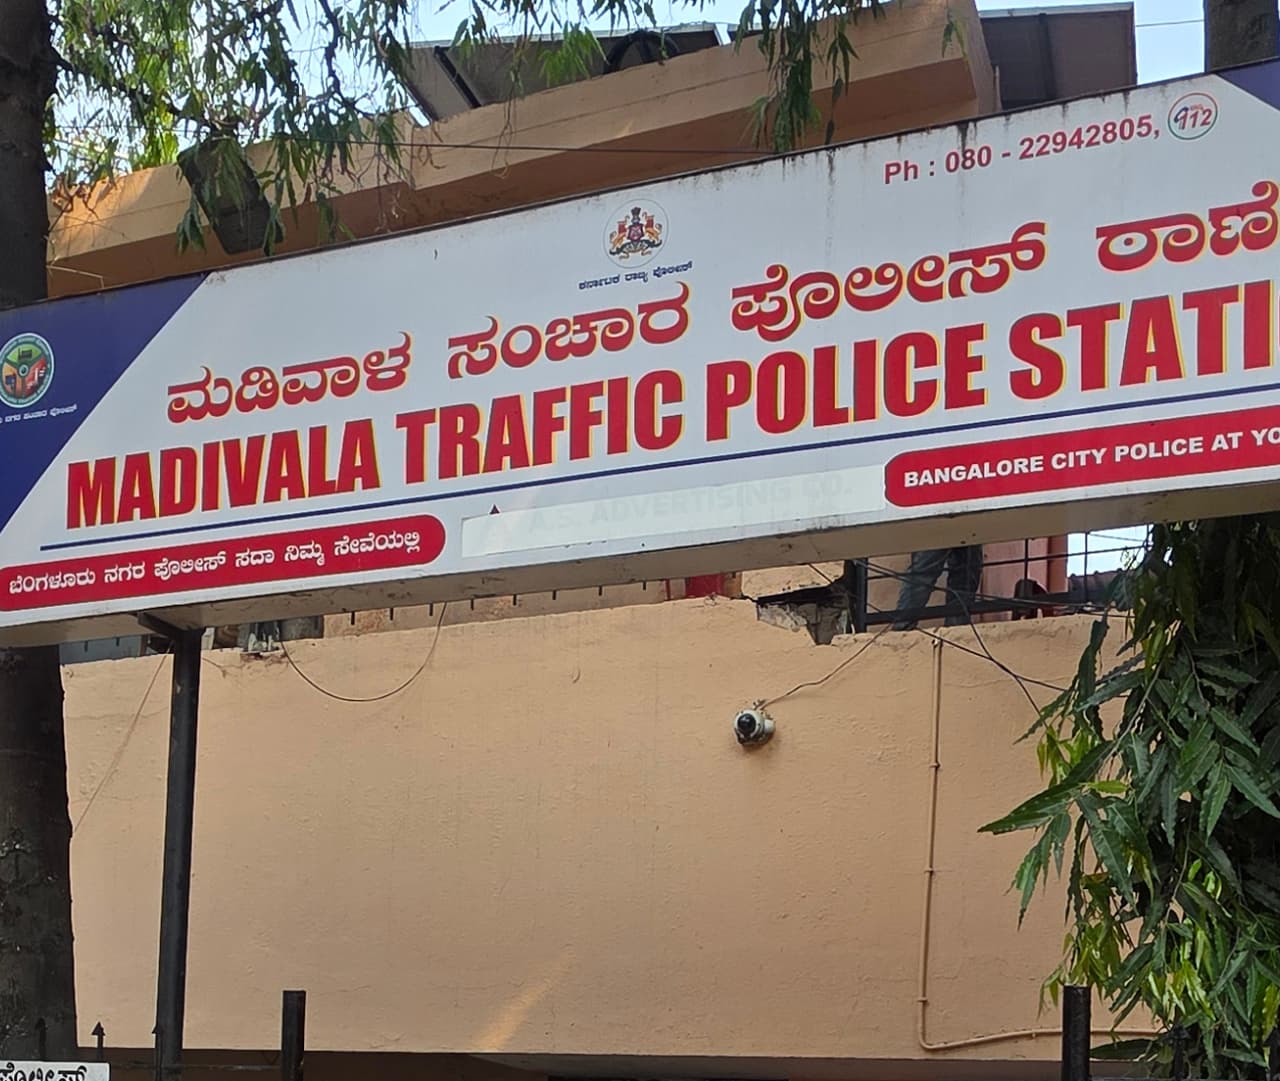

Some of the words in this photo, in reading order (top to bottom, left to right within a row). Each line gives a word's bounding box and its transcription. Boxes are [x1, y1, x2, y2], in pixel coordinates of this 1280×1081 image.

[884, 160, 919, 185] Ph
[945, 145, 992, 174] 080
[1019, 114, 1161, 160] 22942805,
[652, 260, 693, 279] ಪೊಲೀಸ್
[167, 331, 413, 424] ಮಡಿವಾಳ
[447, 280, 692, 379] ಸಂಚಾರ
[730, 221, 1048, 343] ಪೊಲೀಸ್
[65, 417, 381, 530] MADIVALA
[395, 369, 687, 484] TRAFFIC
[705, 322, 988, 443] POLICE
[903, 455, 1044, 488] BANGALORE
[1050, 447, 1107, 471] CITY
[1114, 436, 1204, 463] POLICE
[1210, 432, 1244, 451] AT
[8, 571, 97, 595] ಬೆಂಗಳೂರು
[103, 562, 146, 583] ನಗರ
[153, 550, 228, 580] ಪೊಲೀಸ್
[235, 548, 276, 568] ಸದಾ
[284, 543, 326, 568] ನಿಮ್ಮ
[334, 530, 422, 554] ಸೇವೆಯಲ್ಲಿ
